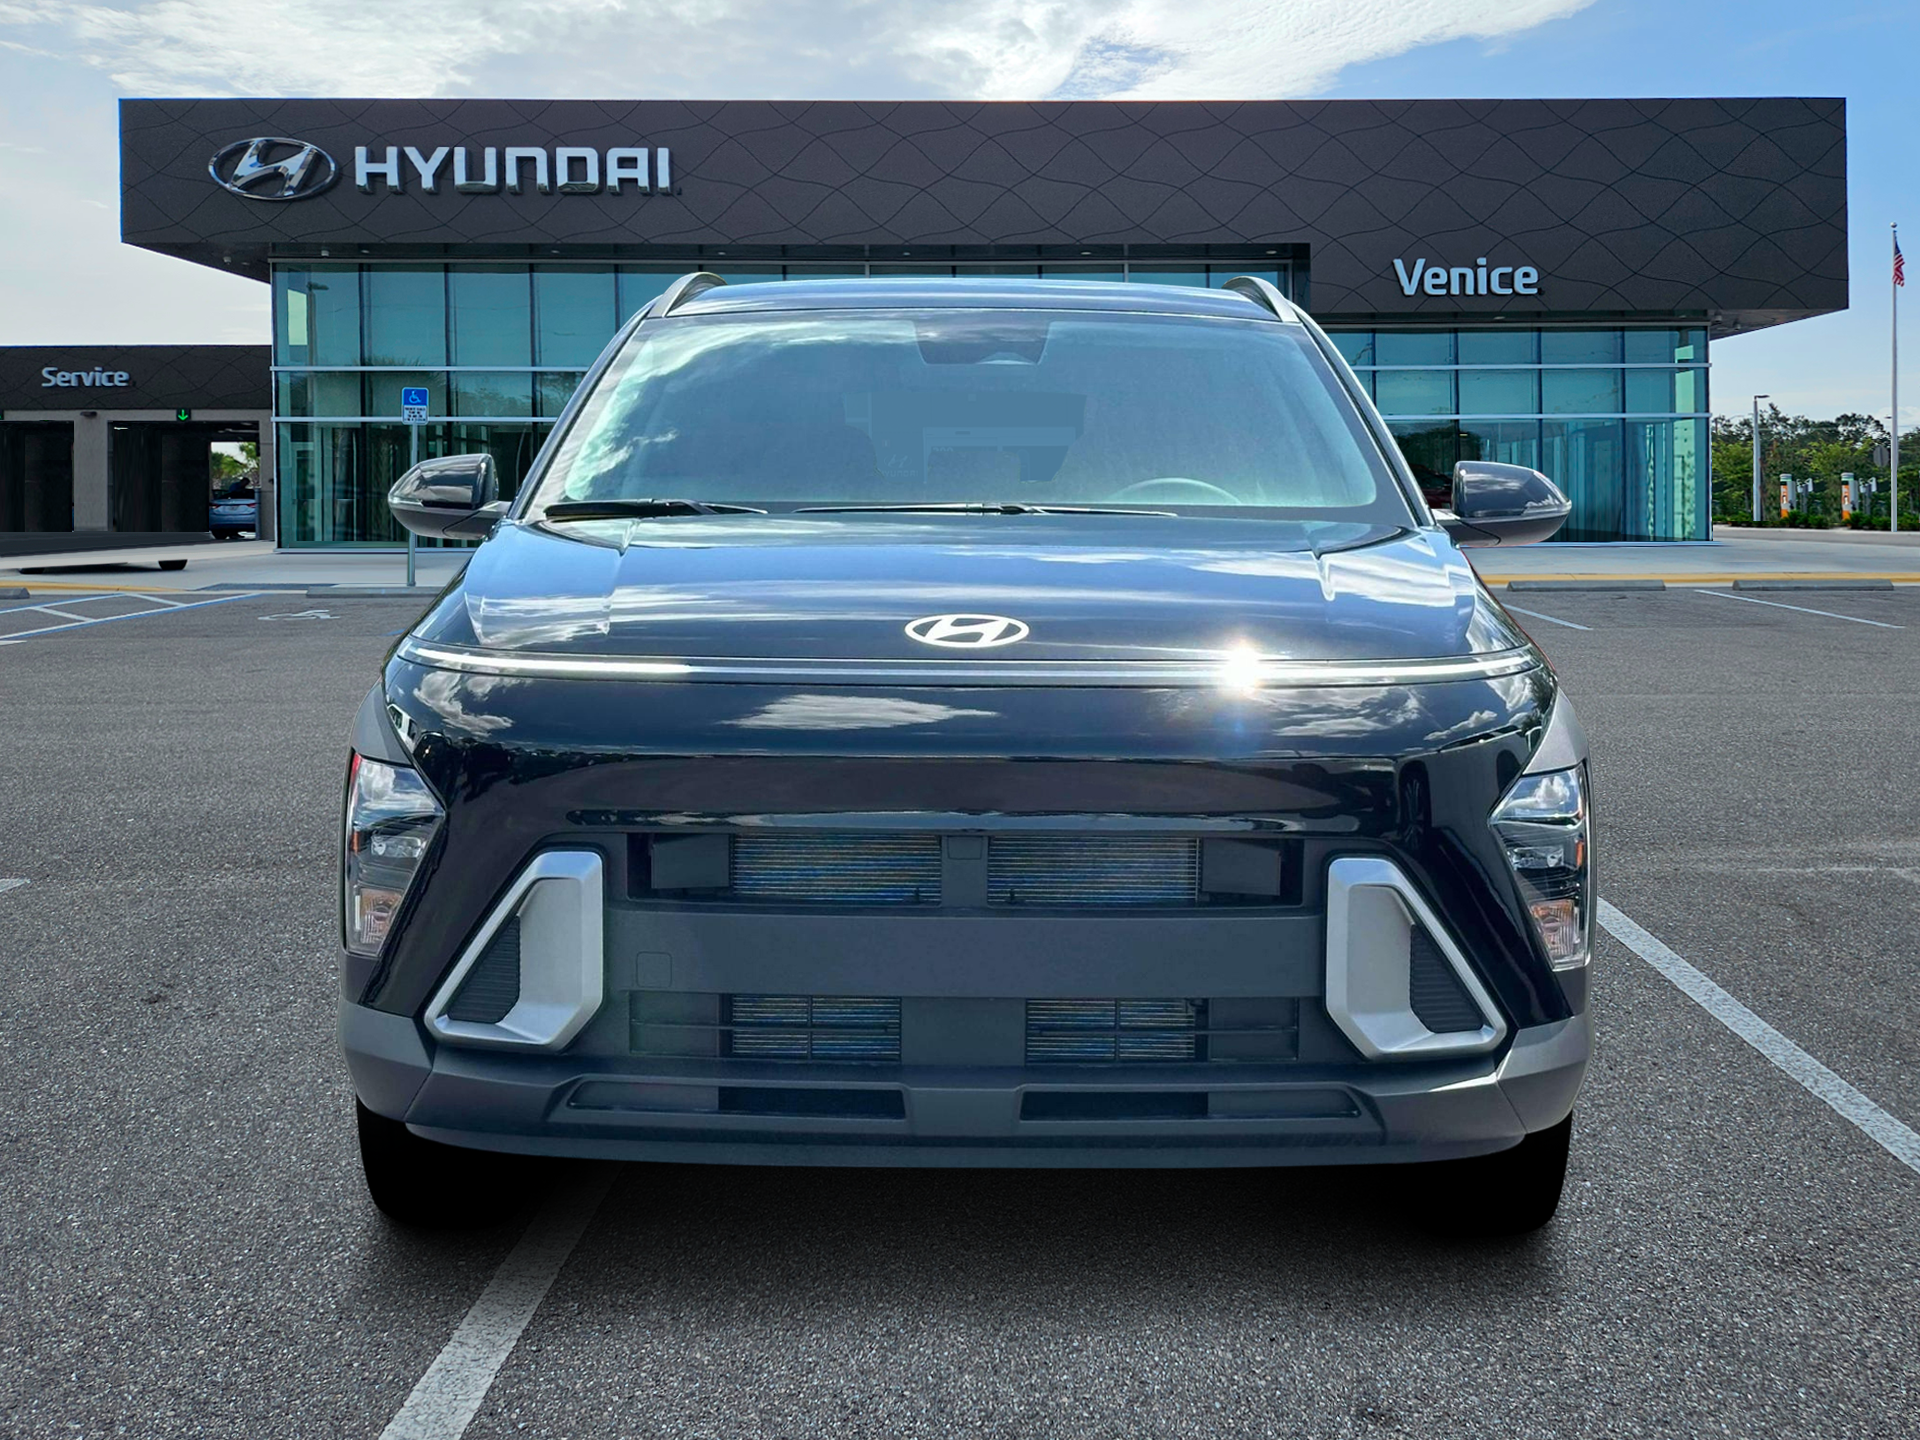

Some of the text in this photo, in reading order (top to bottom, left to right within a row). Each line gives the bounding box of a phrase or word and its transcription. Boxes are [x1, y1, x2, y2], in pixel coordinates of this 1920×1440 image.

[354, 146, 670, 194] HYUNDAI
[1393, 257, 1538, 296] Venice
[41, 366, 130, 387] Service
